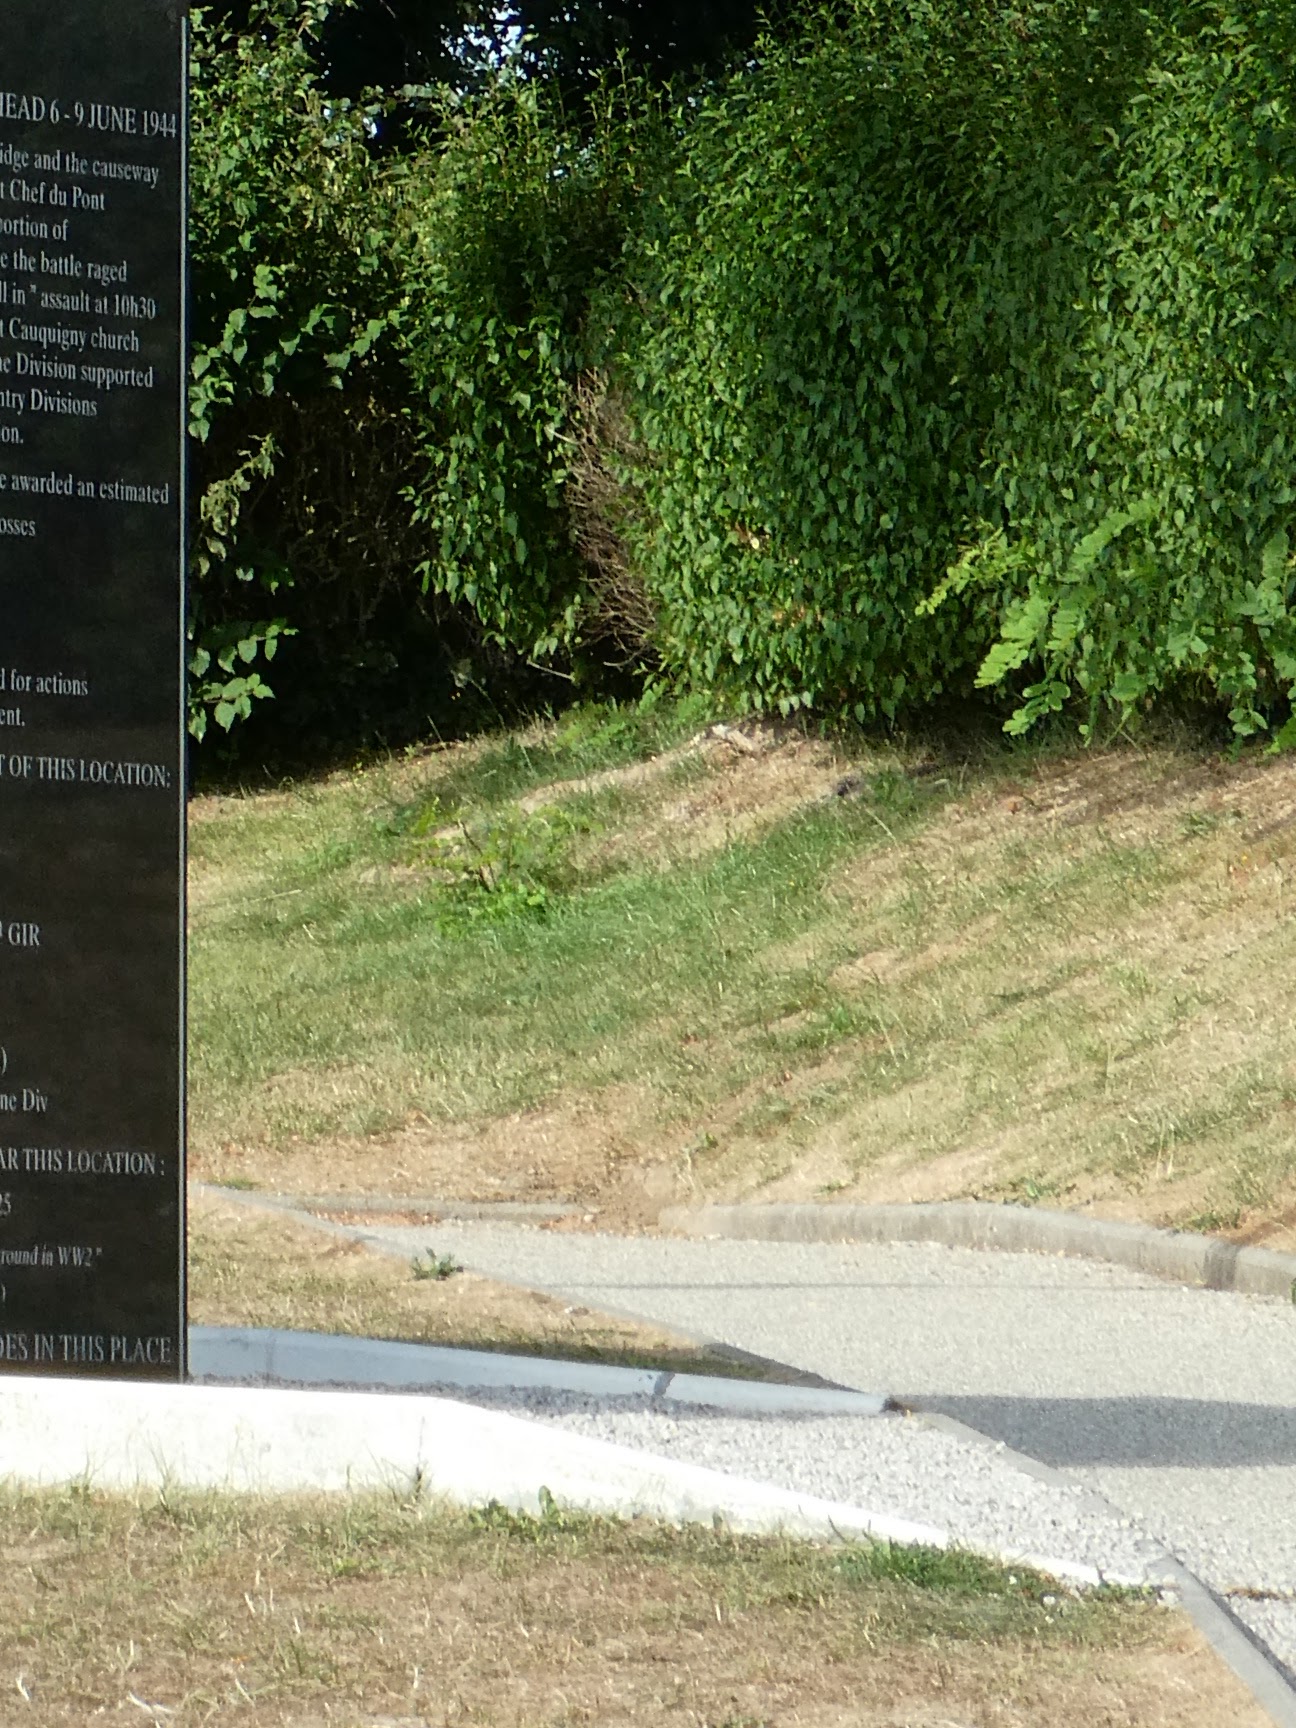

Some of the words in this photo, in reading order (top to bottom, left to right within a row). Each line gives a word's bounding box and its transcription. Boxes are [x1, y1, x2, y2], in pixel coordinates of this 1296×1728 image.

[50, 100, 59, 123] 6
[74, 102, 84, 124] 9
[88, 103, 136, 133] JUNE
[143, 110, 176, 138] 1944
[52, 218, 68, 241] of
[22, 1088, 47, 1112] Div
[34, 1334, 54, 1360] IN
[59, 1334, 104, 1361] THIS
[111, 1335, 170, 1363] PLACE
